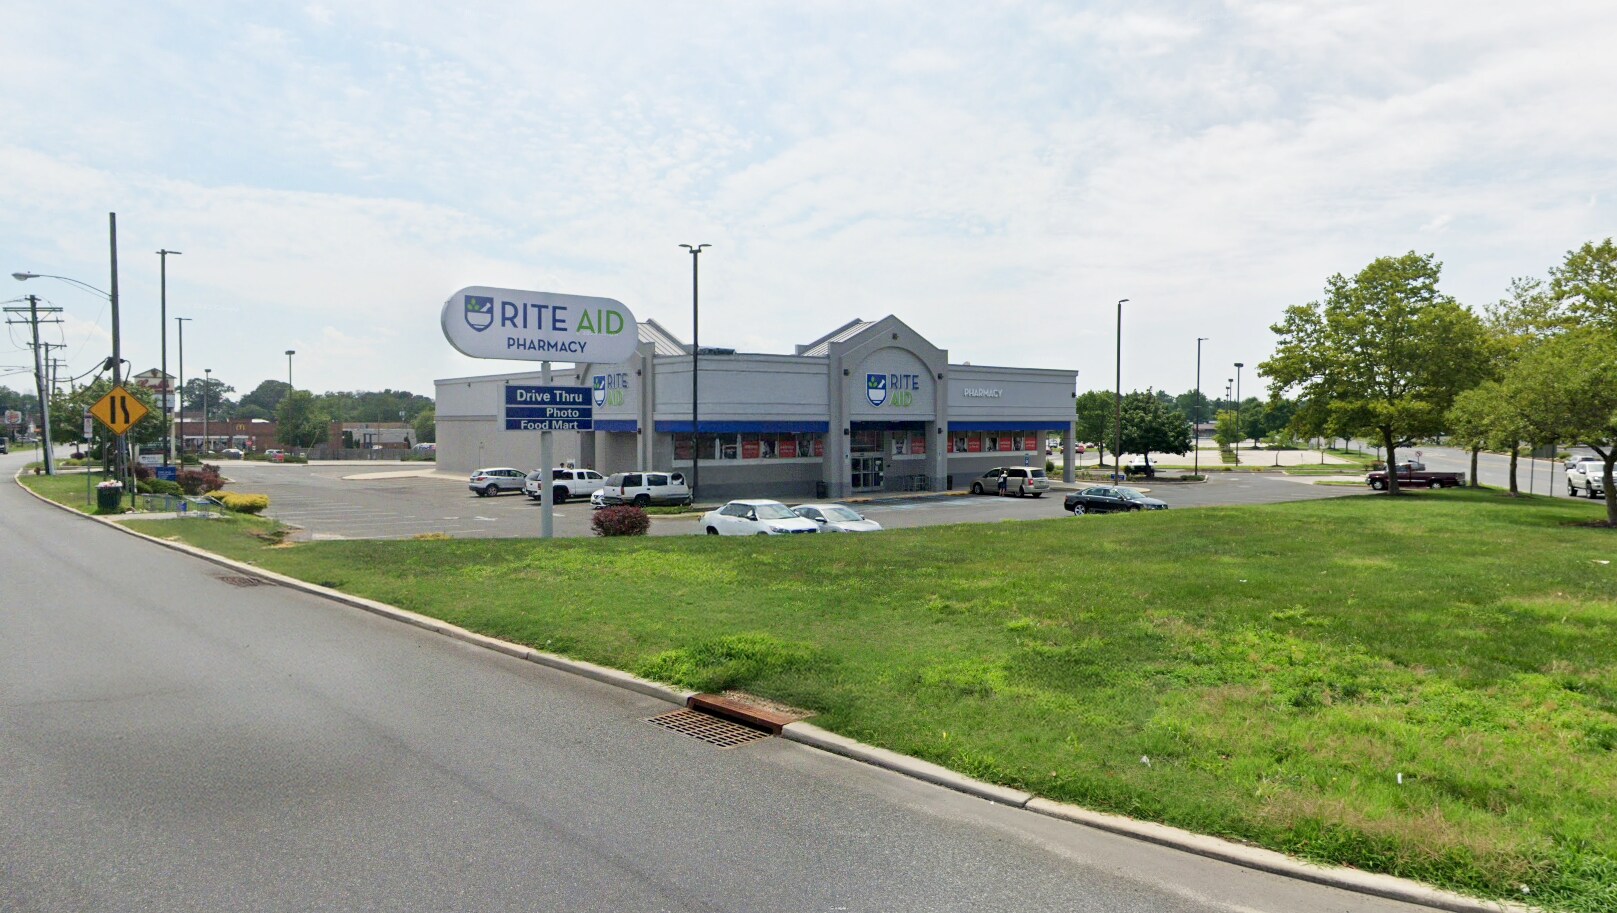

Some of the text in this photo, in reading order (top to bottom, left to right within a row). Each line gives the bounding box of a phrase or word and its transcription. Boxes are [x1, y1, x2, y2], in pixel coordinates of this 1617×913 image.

[501, 301, 624, 335] RITE AID
[507, 337, 587, 353] PHARMACY
[608, 373, 629, 389] RITE
[890, 374, 920, 390] RITE
[516, 389, 583, 402] Drive Thru
[889, 391, 913, 407] AID
[964, 388, 1003, 398] PHARMACY
[546, 407, 579, 418] Photo
[521, 420, 579, 430] Food Mart
